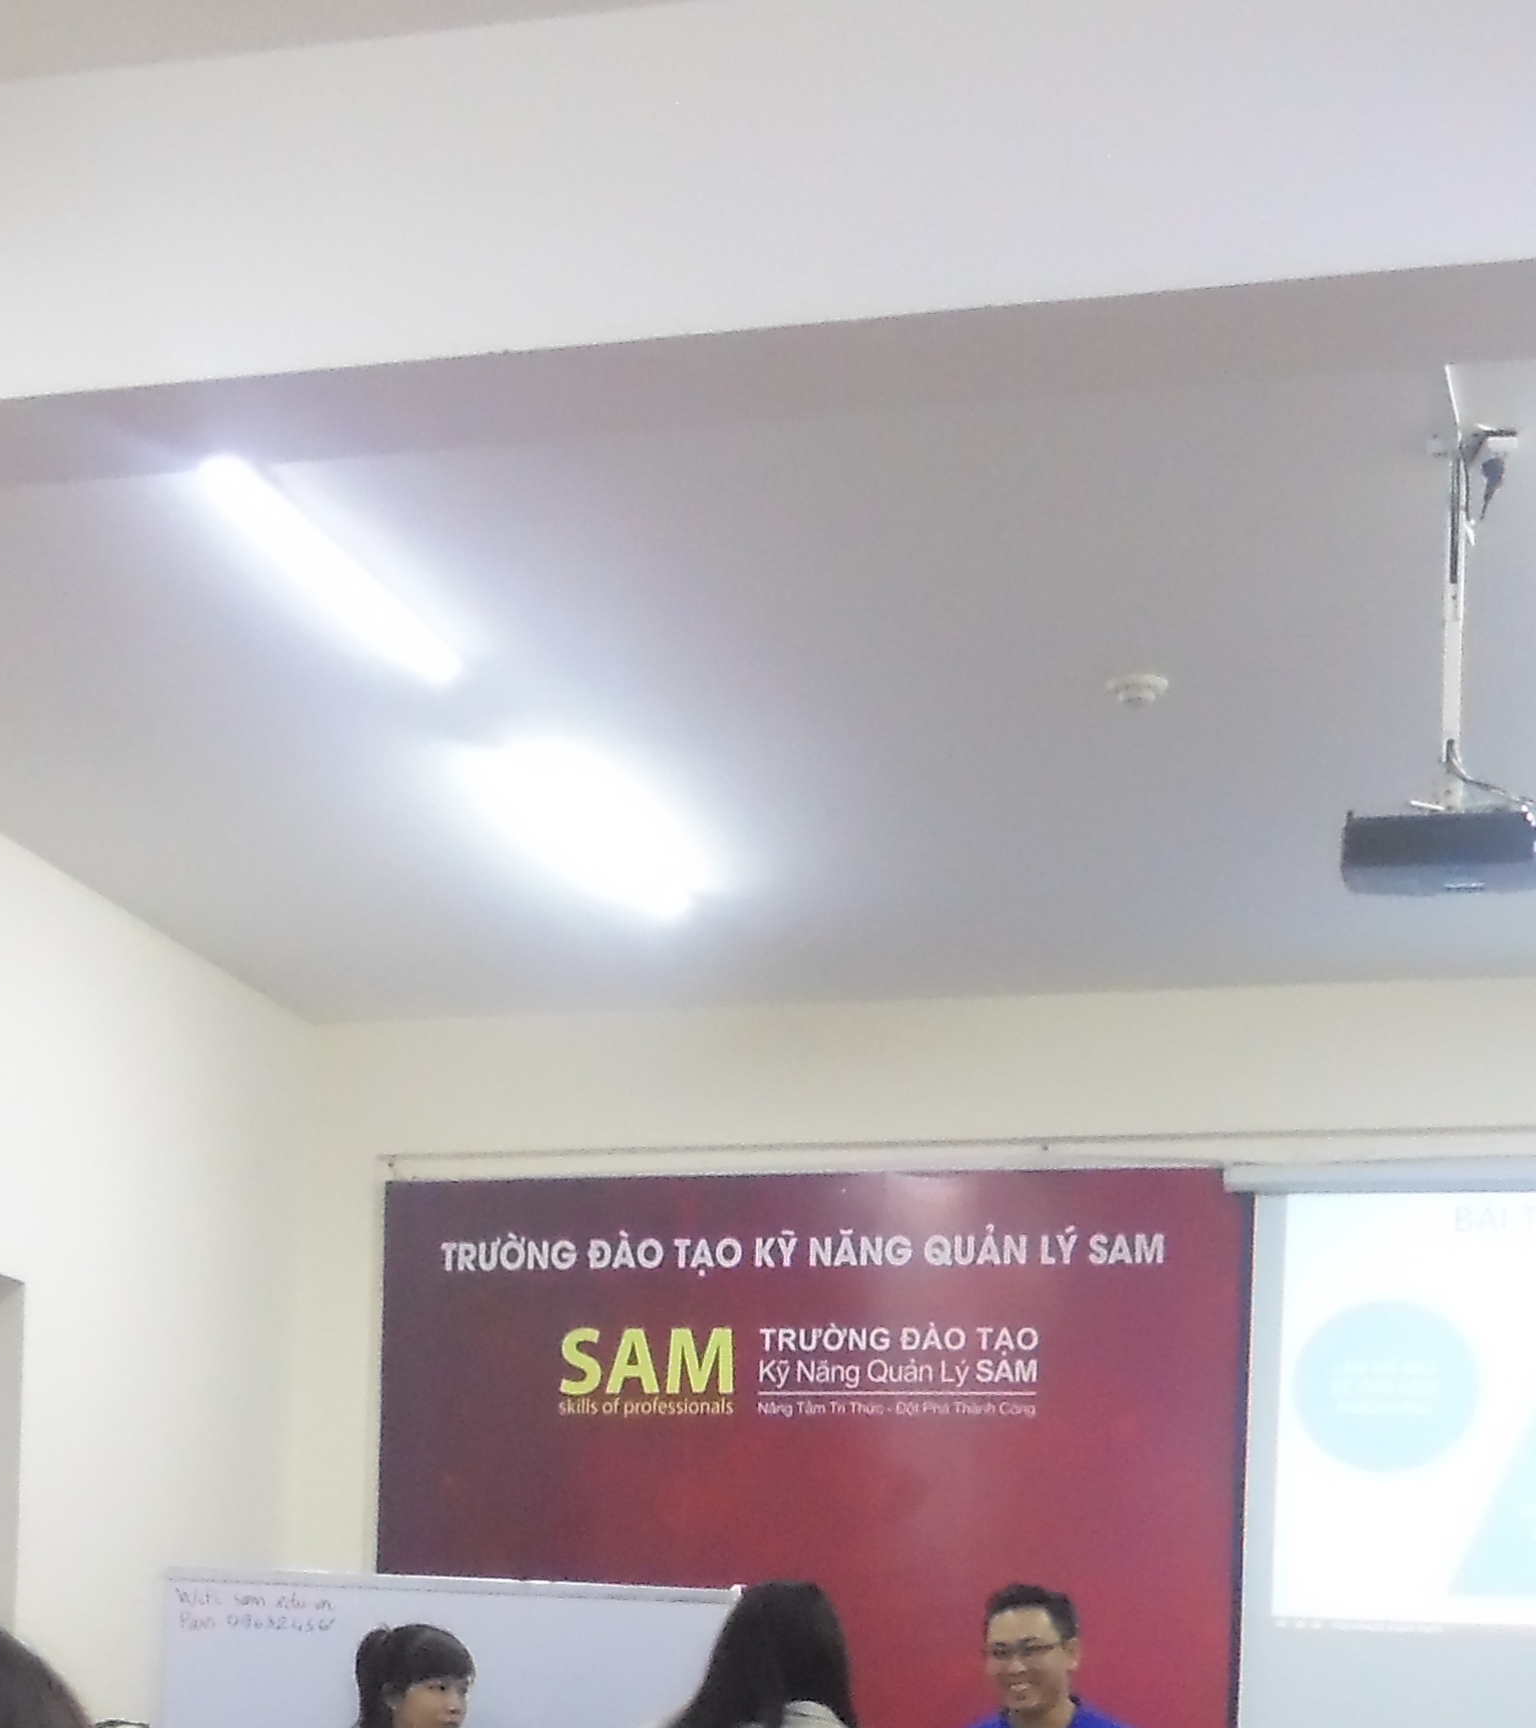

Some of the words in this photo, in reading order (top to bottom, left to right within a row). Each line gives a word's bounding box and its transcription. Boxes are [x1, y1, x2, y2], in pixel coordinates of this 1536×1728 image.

[440, 1232, 577, 1271] TRƯỜNG
[587, 1229, 664, 1269] ĐÀO
[673, 1237, 743, 1277] TẠO
[754, 1229, 798, 1268] KỸ
[809, 1228, 914, 1267] NĂNG
[923, 1223, 1027, 1268] QUẢN
[1040, 1225, 1078, 1266] LÝ
[1088, 1233, 1165, 1265] SAM
[759, 1323, 890, 1352] TRƯỜNG
[900, 1322, 966, 1351] ĐÀO
[976, 1326, 1039, 1356] TẠO
[559, 1326, 734, 1396] SAM
[758, 1359, 791, 1388] Kỹ
[796, 1358, 861, 1388] Năng
[866, 1357, 933, 1384] Quản
[940, 1358, 970, 1387] Lý
[975, 1359, 1038, 1384] SAM
[559, 1397, 598, 1415] skills
[602, 1397, 620, 1415] of
[623, 1397, 734, 1418] professionals
